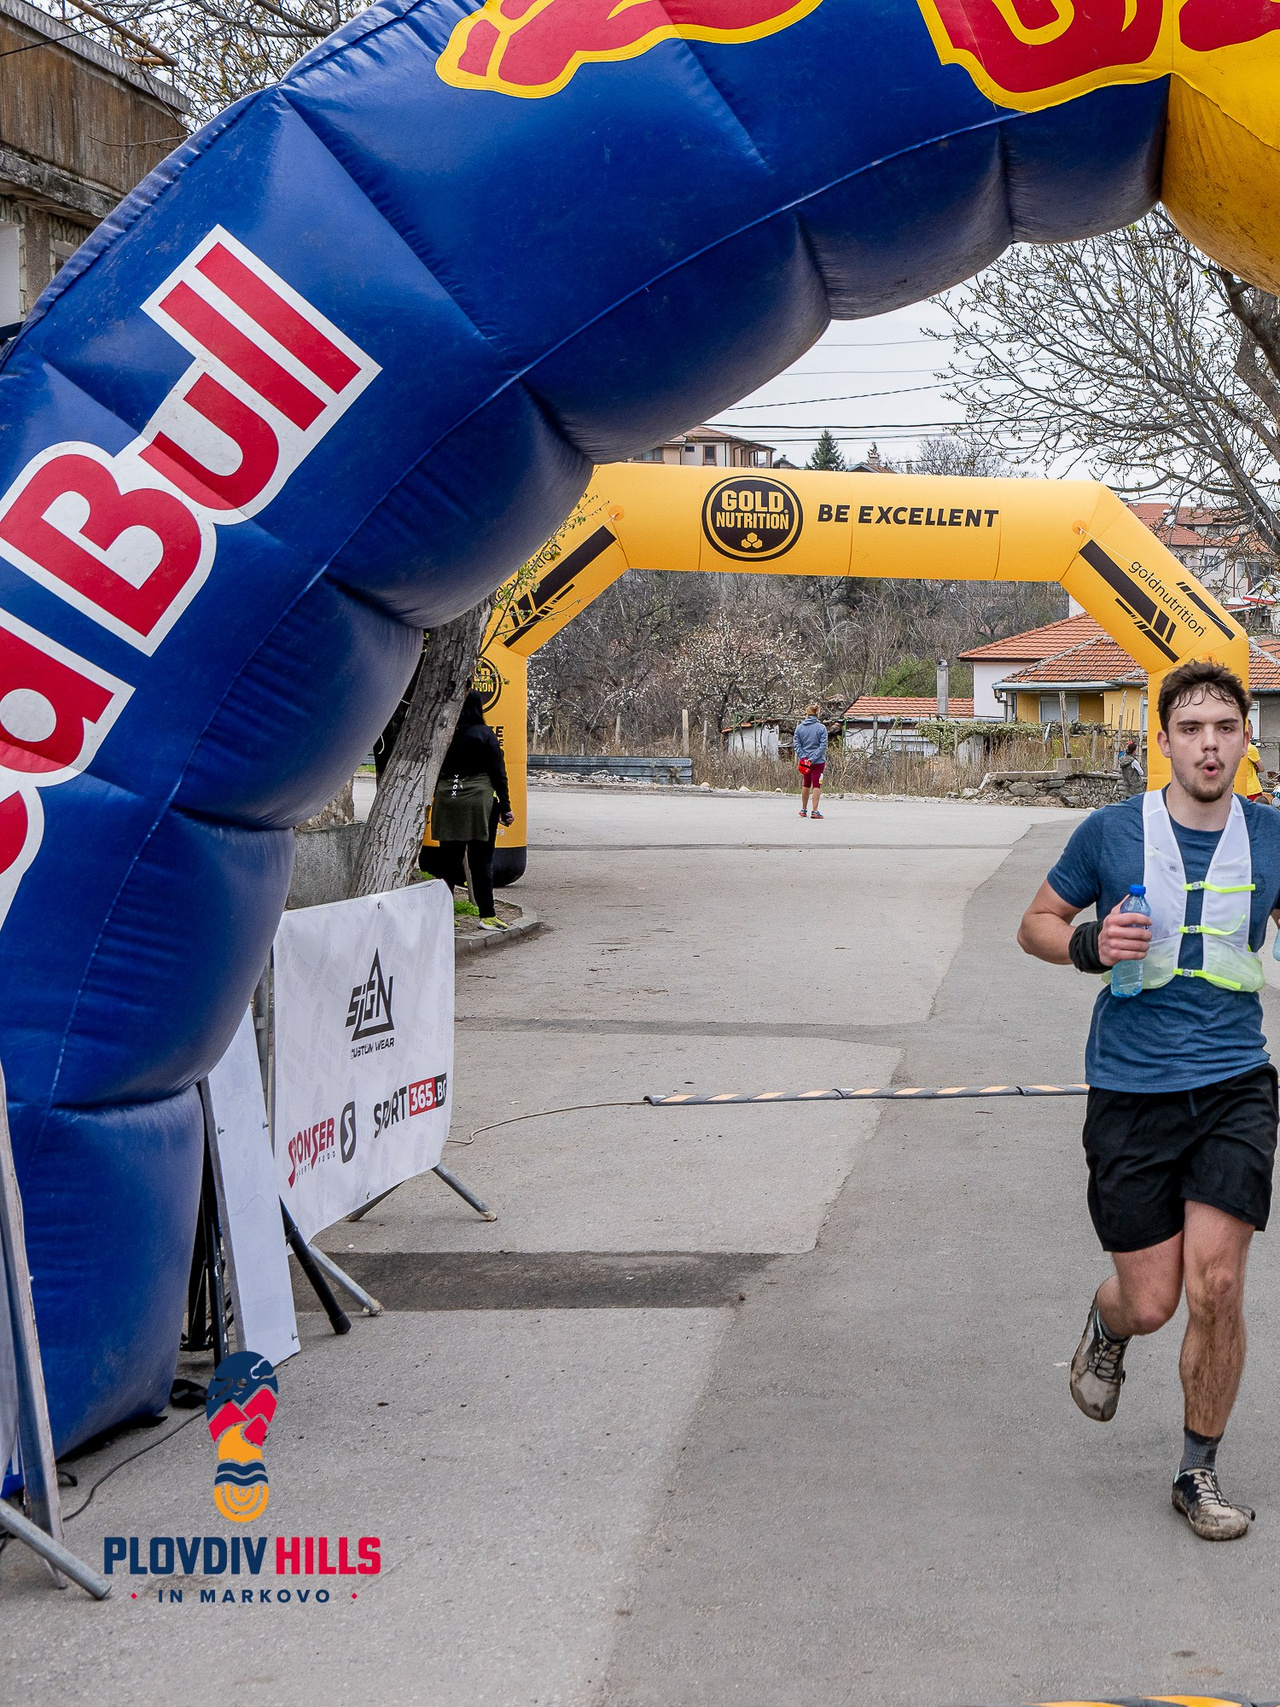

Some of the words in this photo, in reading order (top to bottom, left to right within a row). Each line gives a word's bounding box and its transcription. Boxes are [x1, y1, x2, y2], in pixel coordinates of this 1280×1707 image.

[721, 490, 784, 512] GOLD
[716, 511, 789, 530] NUTRITION
[817, 504, 850, 523] BE
[858, 505, 999, 528] EXCELLENT
[1128, 560, 1206, 638] goldnutrition
[375, 1037, 395, 1051] WEAR
[288, 1117, 335, 1188] SPONSER
